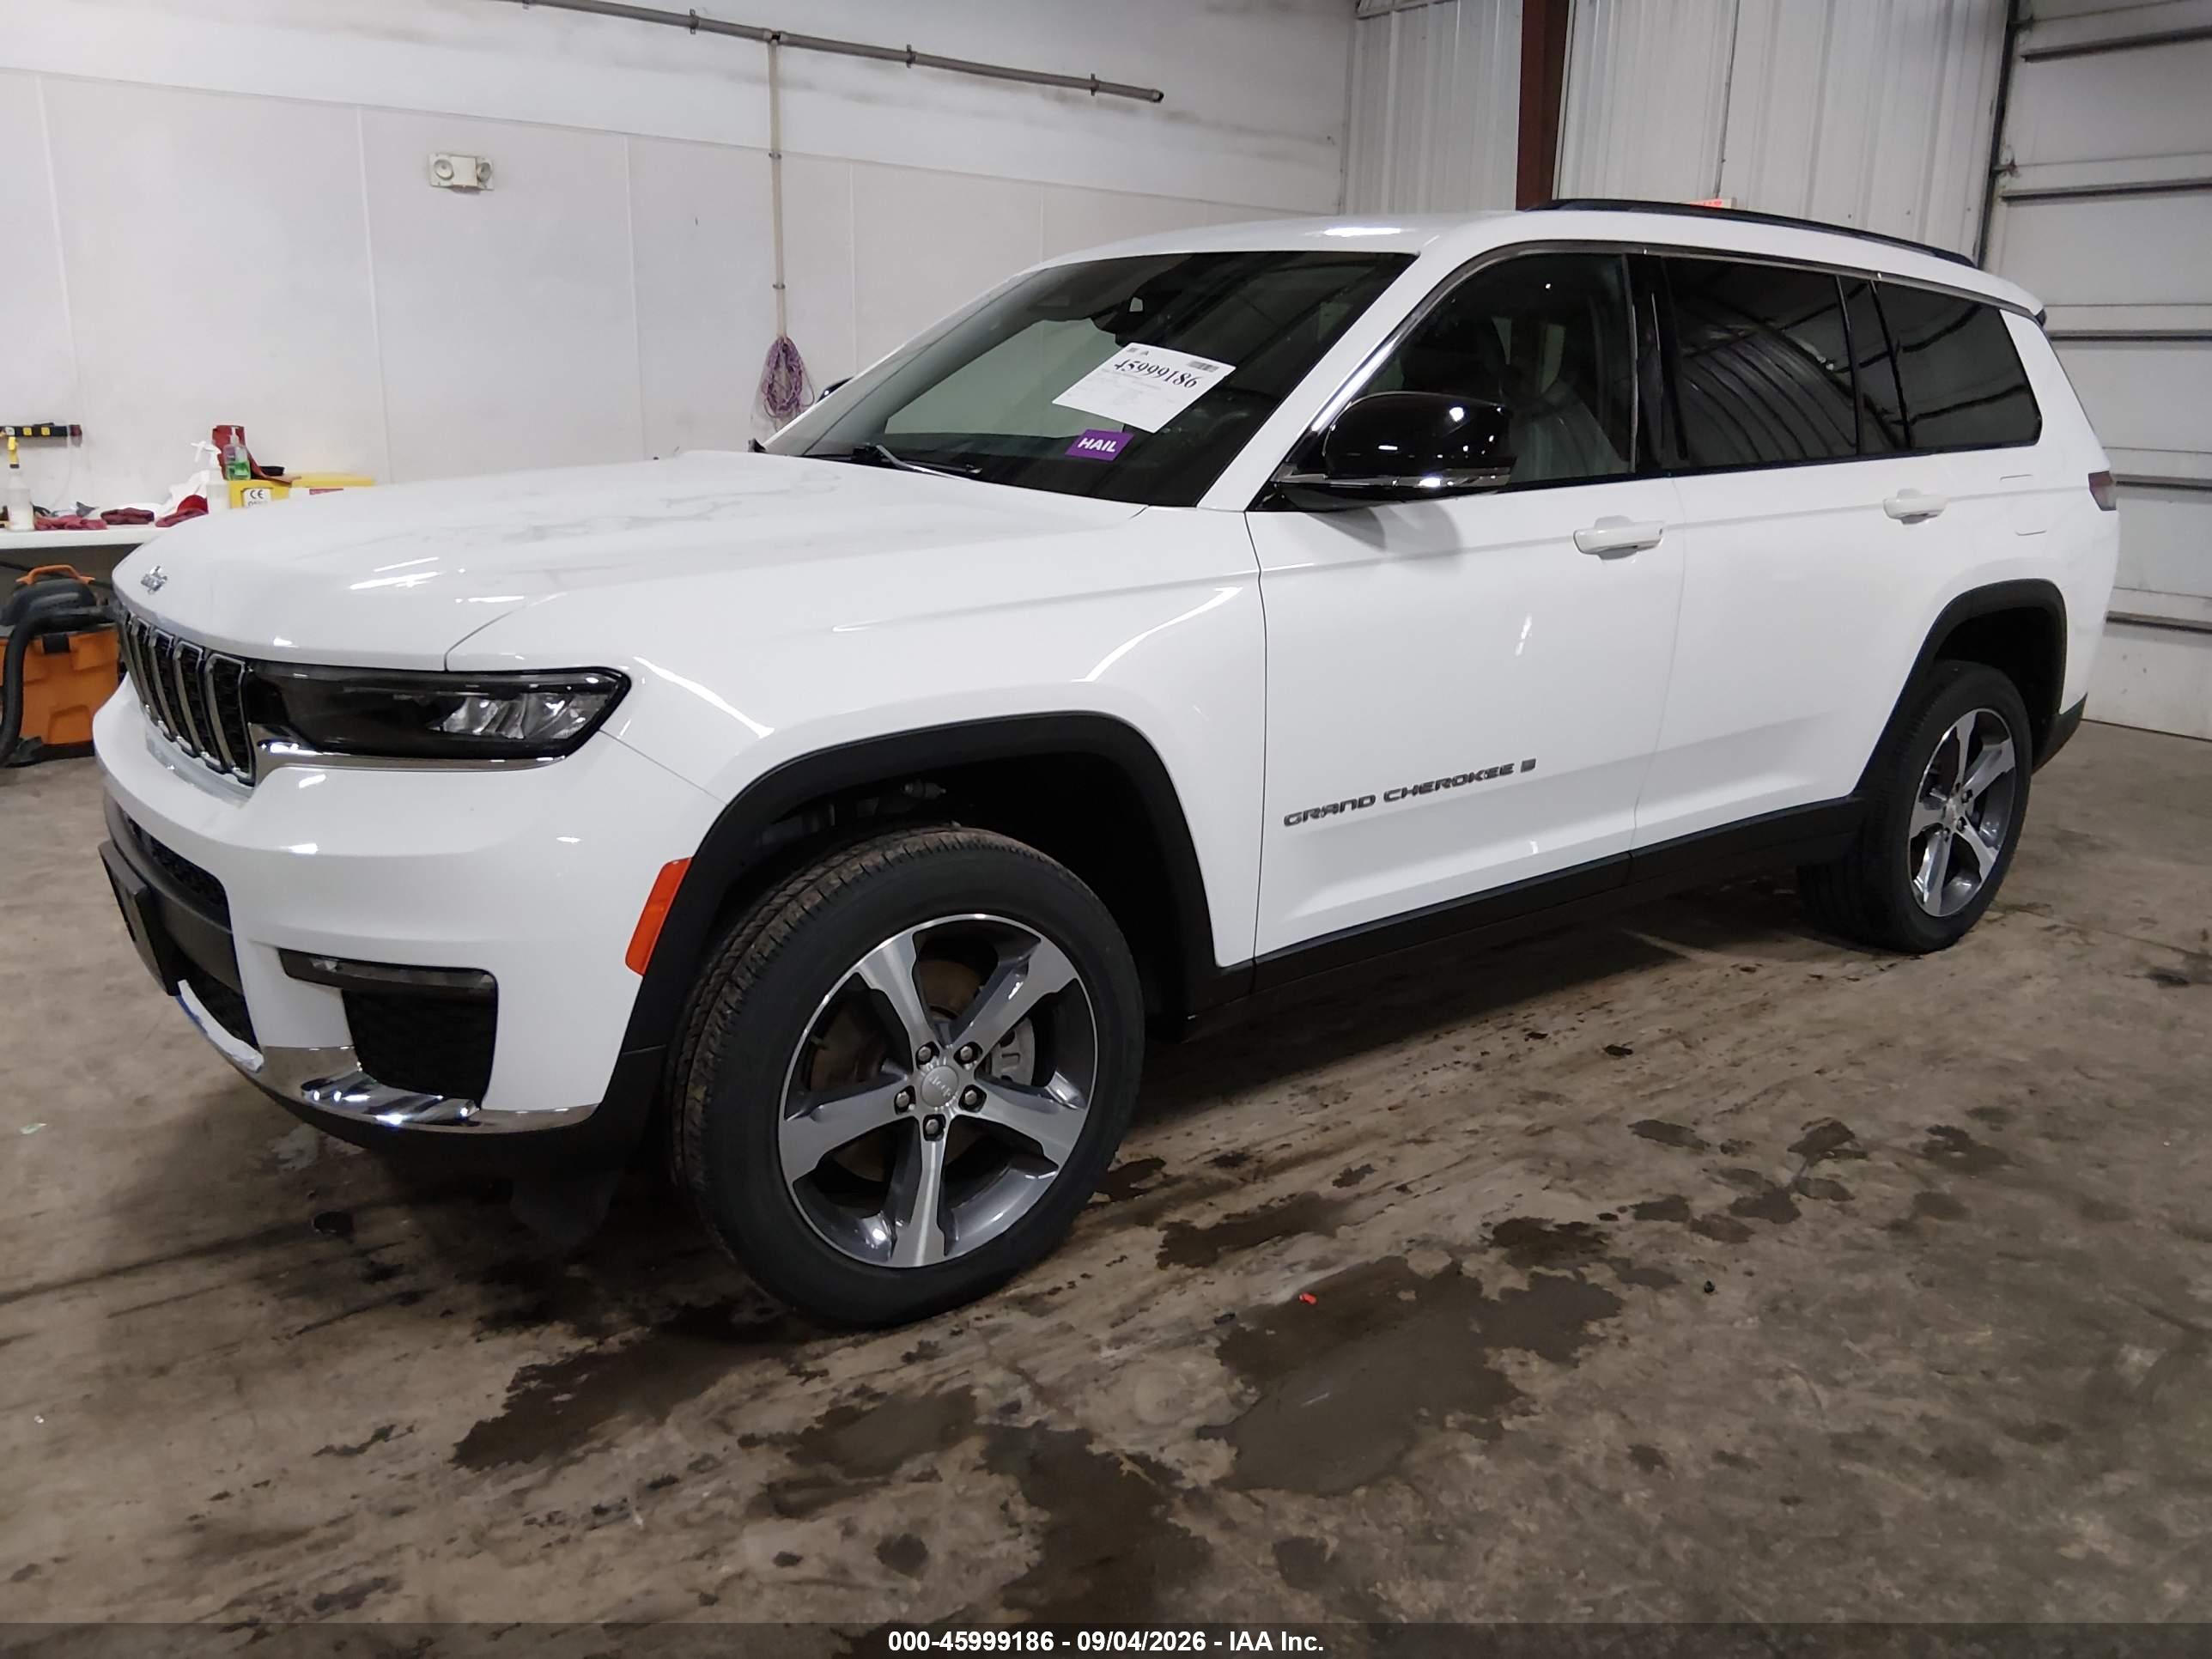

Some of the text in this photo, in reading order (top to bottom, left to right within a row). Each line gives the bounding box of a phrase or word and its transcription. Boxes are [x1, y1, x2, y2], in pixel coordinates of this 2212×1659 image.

[1114, 359, 1203, 388] 45999186
[1078, 438, 1116, 453] HAIL
[1284, 763, 1515, 827] GRAND CHEROKEE
